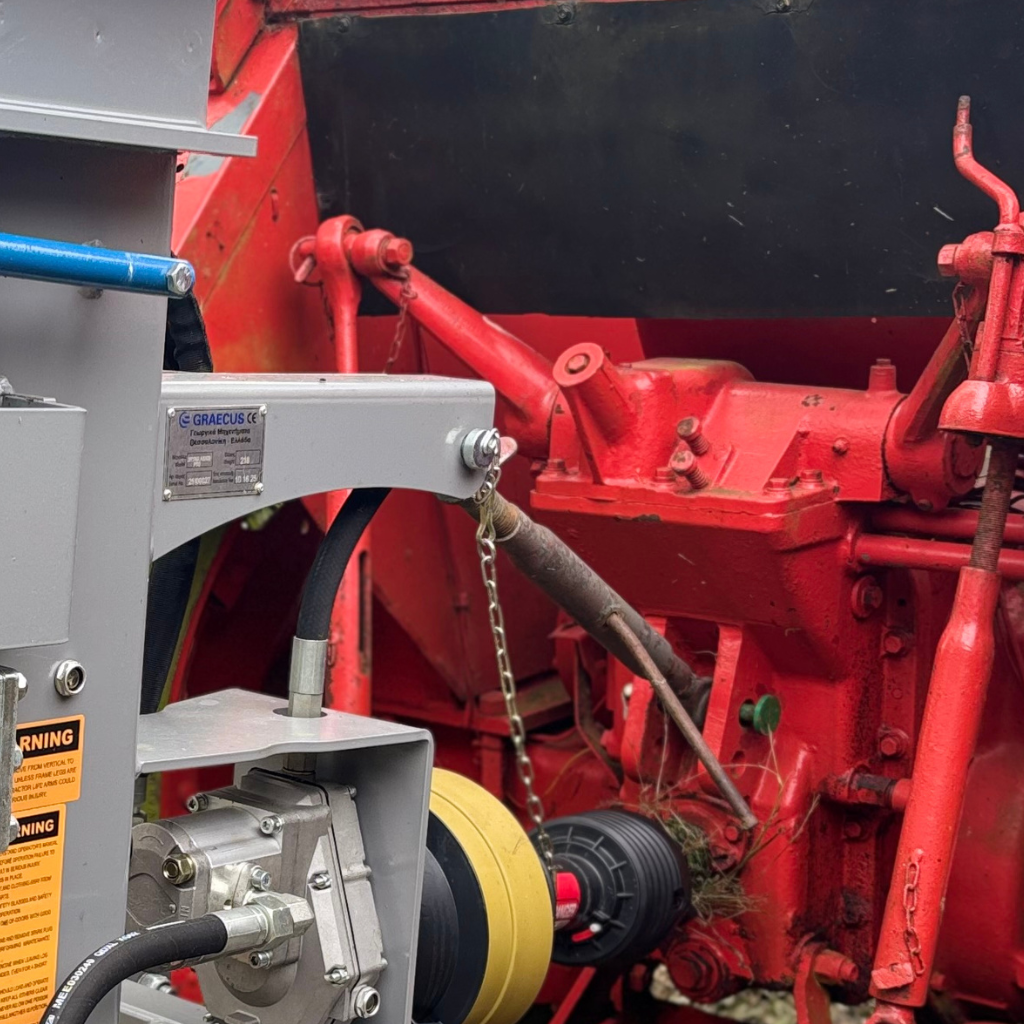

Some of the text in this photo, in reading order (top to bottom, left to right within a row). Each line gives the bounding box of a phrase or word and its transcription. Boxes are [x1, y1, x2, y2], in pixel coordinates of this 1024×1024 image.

[193, 412, 244, 426] GRAECUS
[20, 729, 73, 752] RNING
[12, 784, 31, 793] ACTOR
